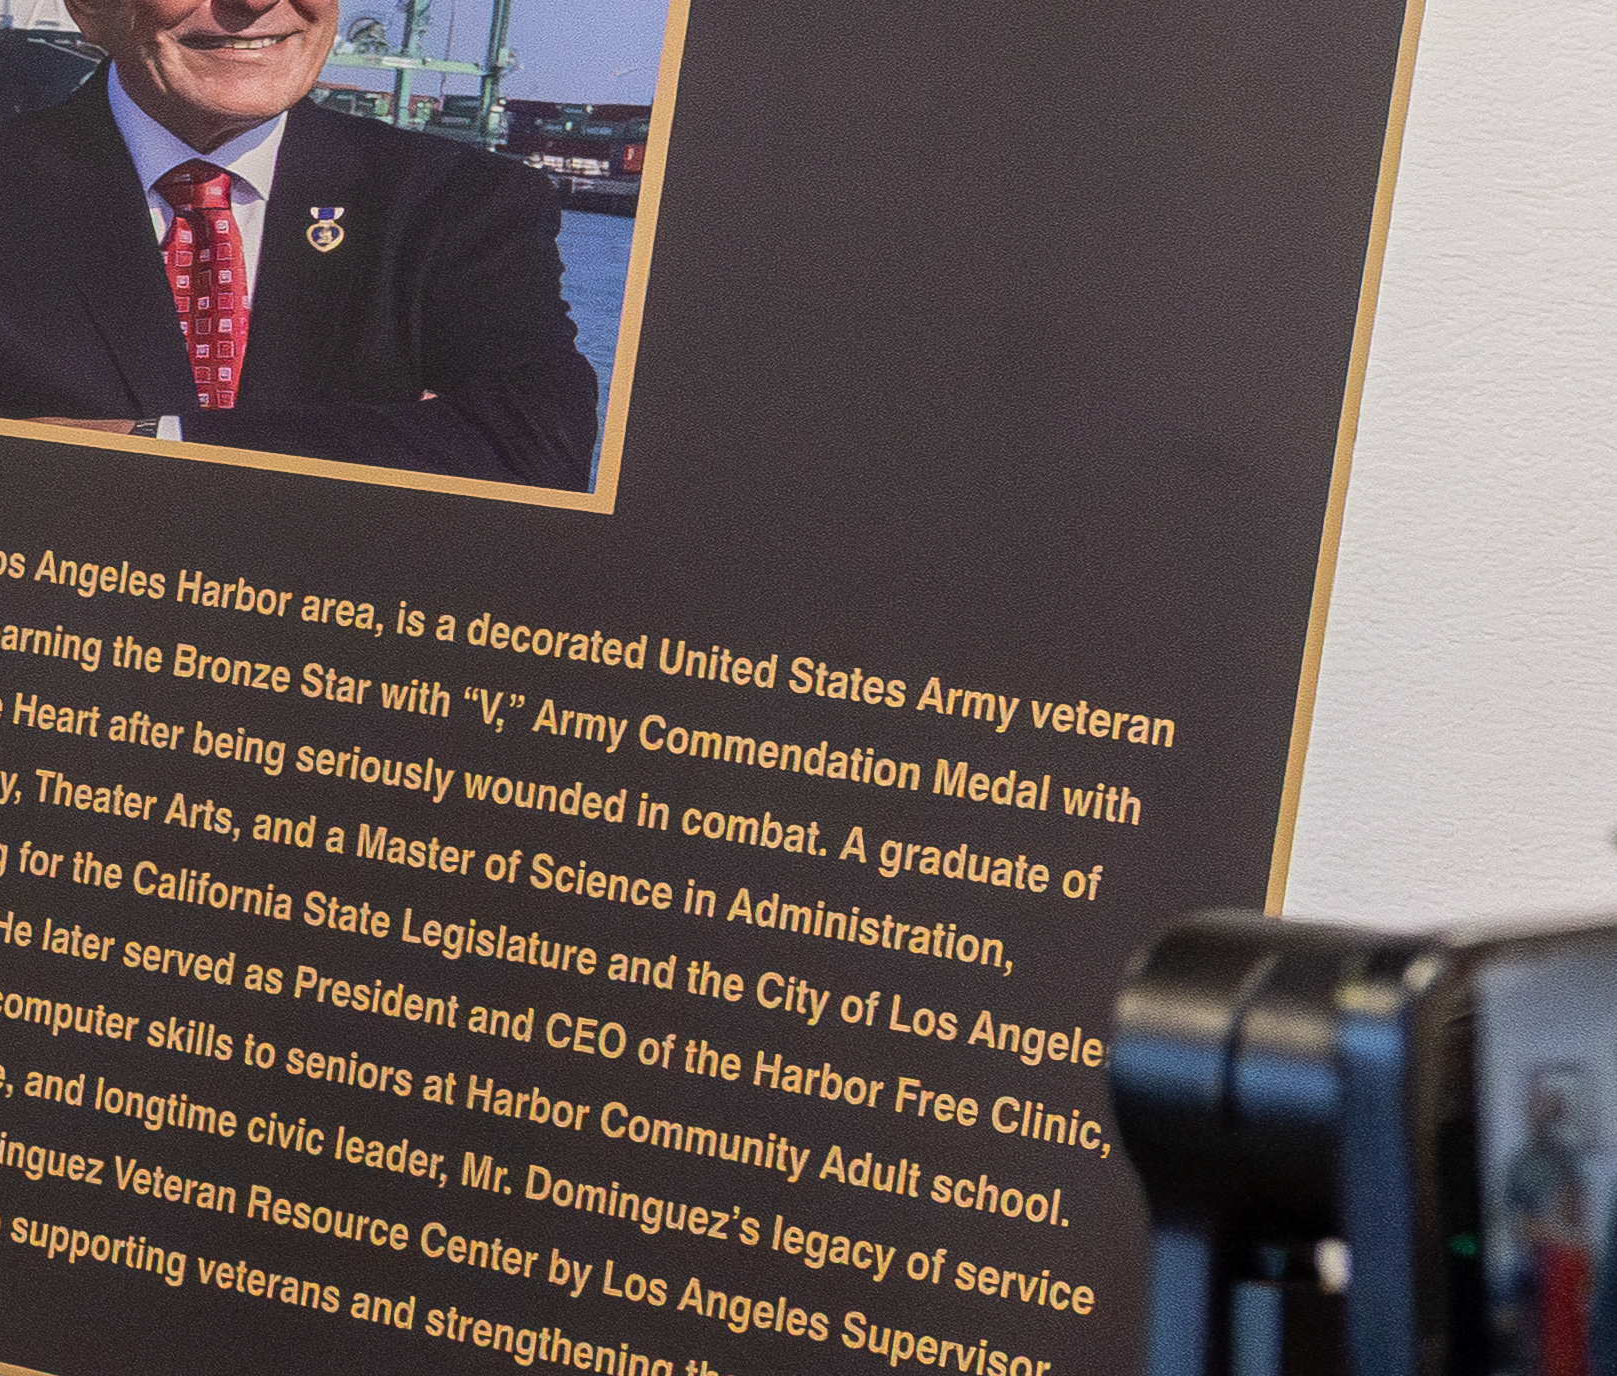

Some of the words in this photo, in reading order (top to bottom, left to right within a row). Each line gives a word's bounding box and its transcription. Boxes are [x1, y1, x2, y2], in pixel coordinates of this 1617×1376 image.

[32, 548, 167, 601] Angeles
[175, 568, 294, 618] Harbor
[299, 593, 385, 639] area,
[395, 599, 427, 638] is
[434, 613, 457, 643] a
[466, 611, 649, 671] decorated
[657, 636, 780, 690] United
[787, 655, 908, 709] States
[914, 675, 1021, 735] Army
[1029, 699, 1177, 749] veteran
[111, 634, 164, 675] the
[171, 642, 292, 694] Bronze
[299, 661, 374, 706] Star
[379, 678, 452, 719] with
[462, 685, 526, 734] “V,”
[530, 697, 630, 755] Army
[637, 713, 922, 792] Commendation
[931, 757, 1053, 813] Medal
[1061, 781, 1143, 827] with
[11, 691, 102, 739] Heart
[106, 709, 186, 752] after
[191, 719, 288, 778] being
[294, 744, 456, 805] seriously
[463, 771, 629, 824] wounded
[635, 791, 671, 832] in
[680, 806, 828, 858] combat.
[837, 824, 868, 865] A
[876, 838, 1051, 894] graduate
[1060, 863, 1105, 903] of
[9, 1215, 188, 1289] supporting
[196, 1256, 341, 1315] veterans
[348, 1291, 417, 1331] and
